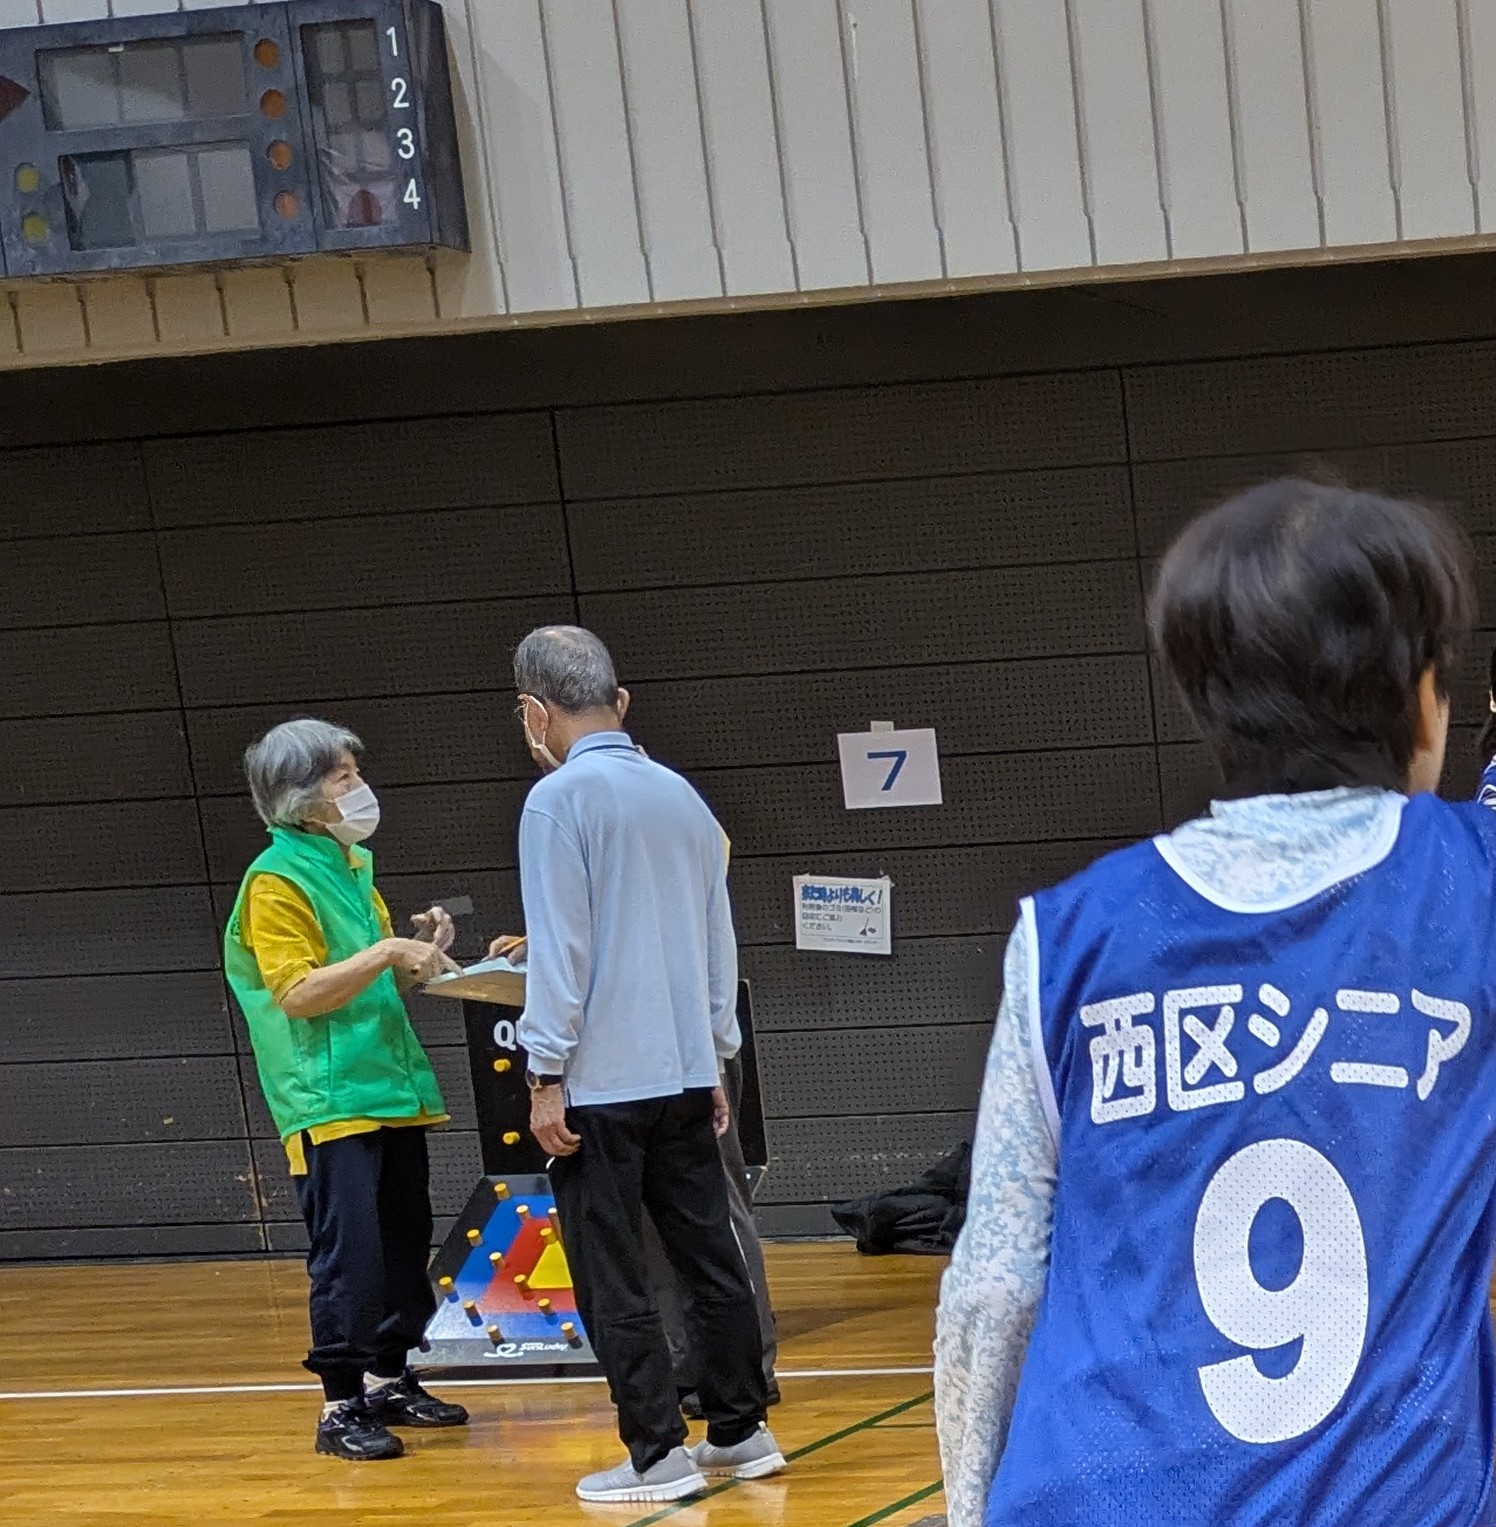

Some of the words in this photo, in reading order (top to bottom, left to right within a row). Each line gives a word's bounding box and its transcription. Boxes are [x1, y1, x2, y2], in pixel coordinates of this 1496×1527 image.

[385, 26, 399, 57] 1
[390, 77, 410, 109] 2
[396, 128, 416, 159] 3
[402, 178, 422, 210] 4
[866, 750, 908, 792] 7
[1079, 983, 1473, 1125] 西区シニア
[1192, 1137, 1370, 1445] 9
